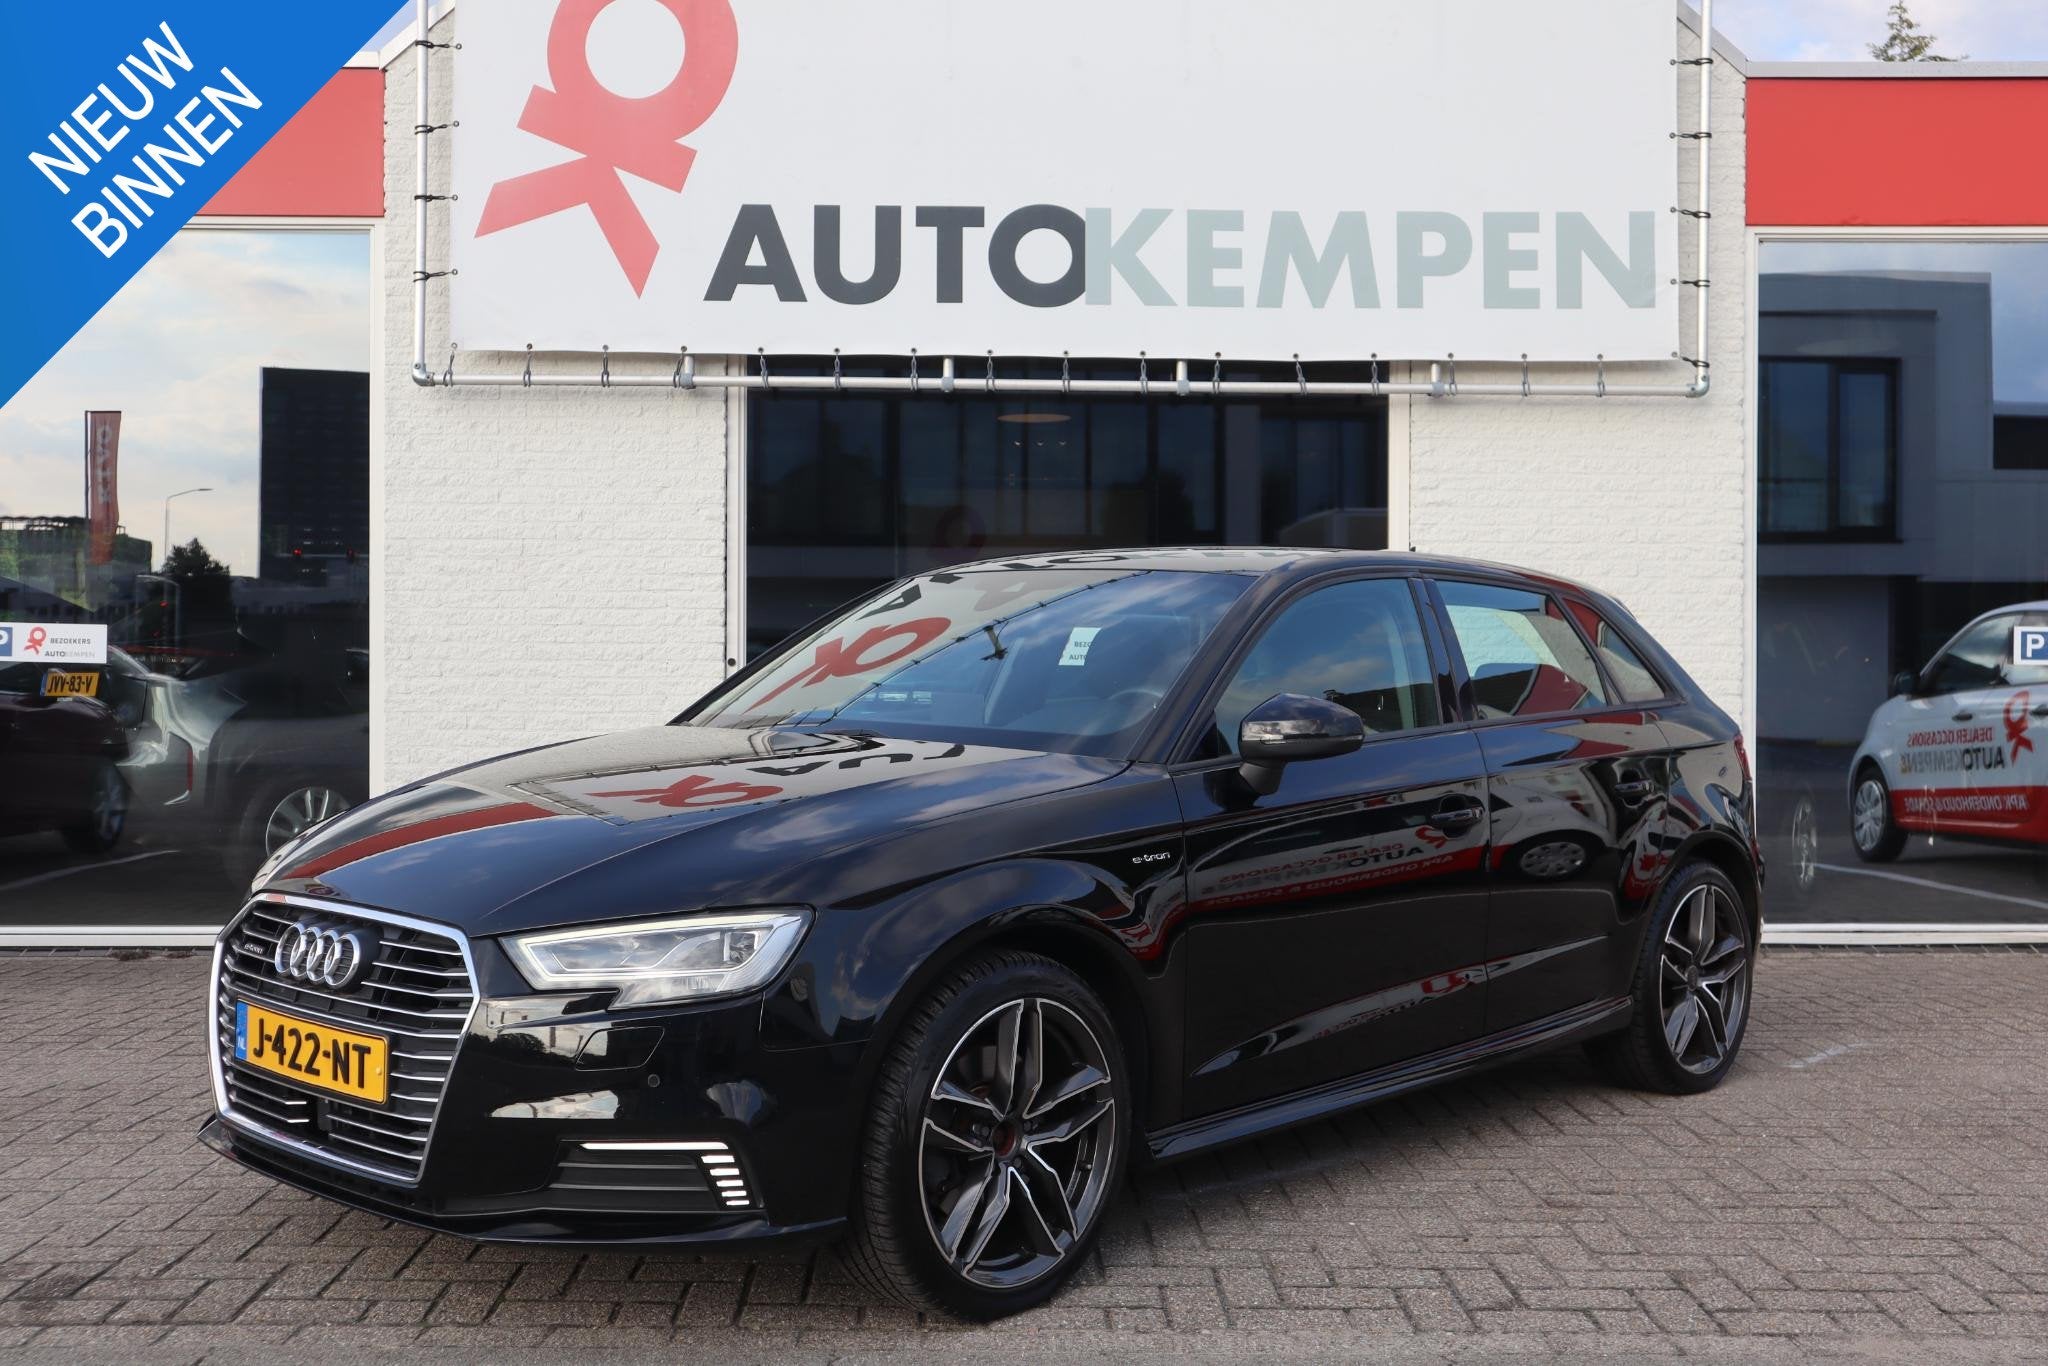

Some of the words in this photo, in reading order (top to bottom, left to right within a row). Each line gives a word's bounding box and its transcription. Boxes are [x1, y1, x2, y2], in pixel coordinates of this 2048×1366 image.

[703, 203, 1656, 309] AUTOKEMPEN
[50, 637, 91, 645] BEZOEKERS
[2026, 633, 2045, 658] P
[1132, 851, 1170, 864] e-tron
[253, 1018, 371, 1089] J-422-NT
